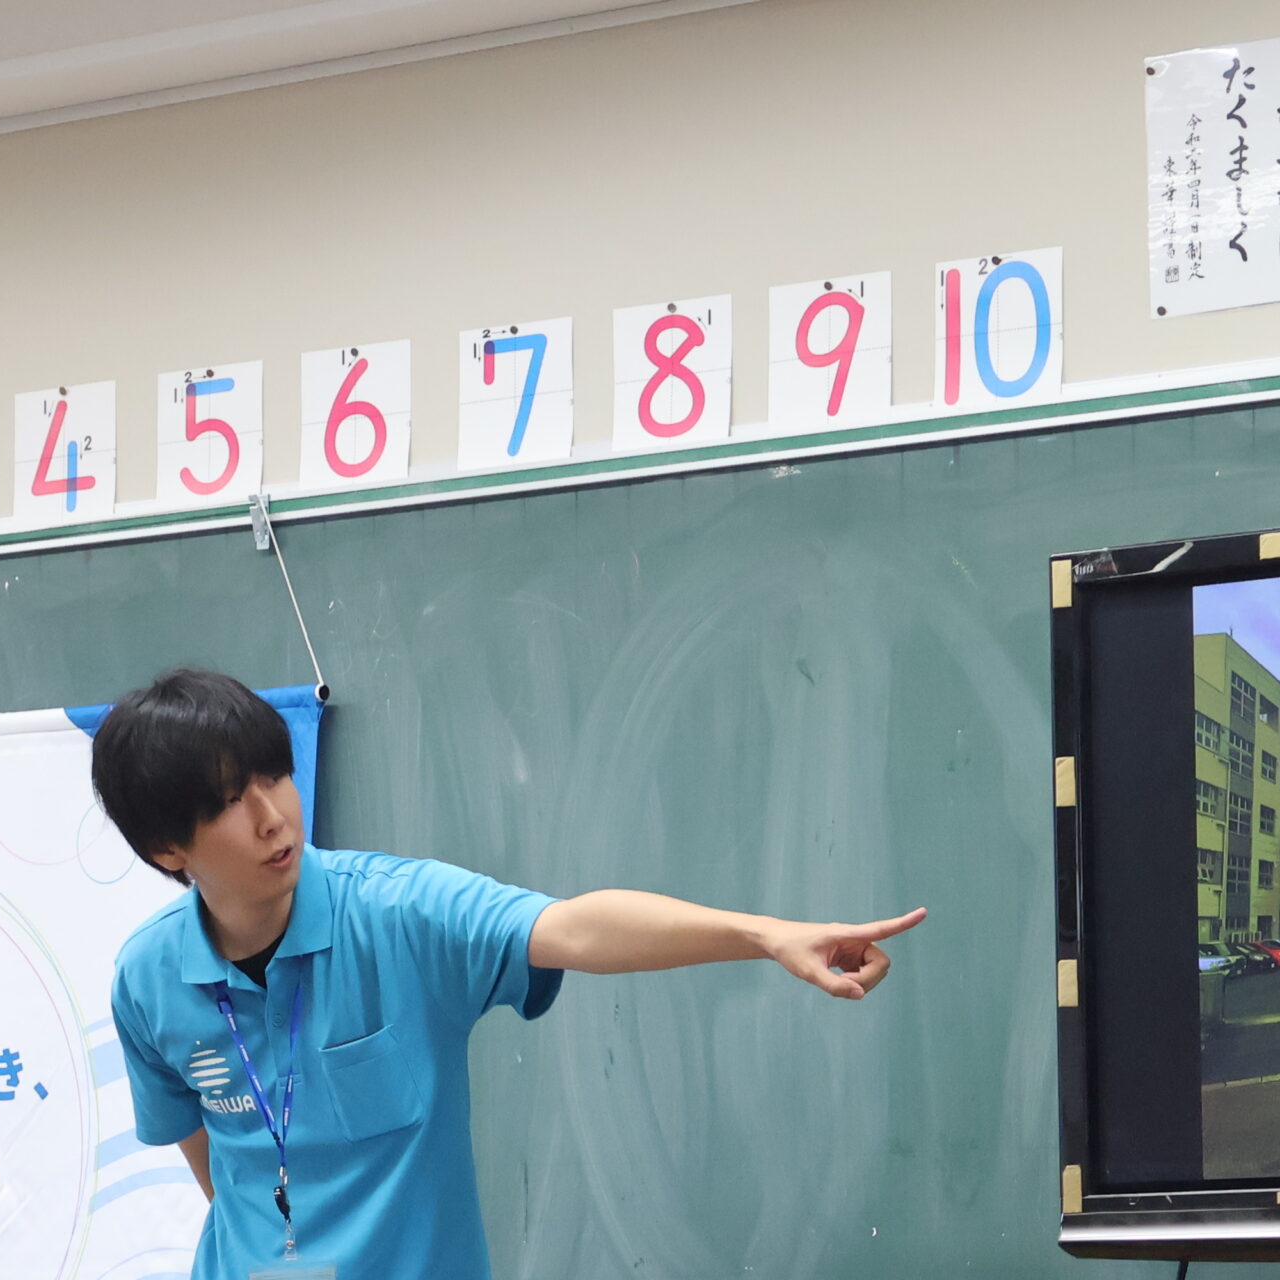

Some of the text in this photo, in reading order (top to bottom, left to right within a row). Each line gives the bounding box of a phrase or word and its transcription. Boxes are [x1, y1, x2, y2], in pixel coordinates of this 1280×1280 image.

[1222, 57, 1256, 263] たくましく
[483, 333, 548, 457] 7
[638, 314, 706, 438] 8
[795, 291, 865, 416] 9
[944, 260, 1051, 406] 10
[31, 400, 96, 512] 4
[179, 377, 240, 495] 5
[323, 358, 387, 478] 6
